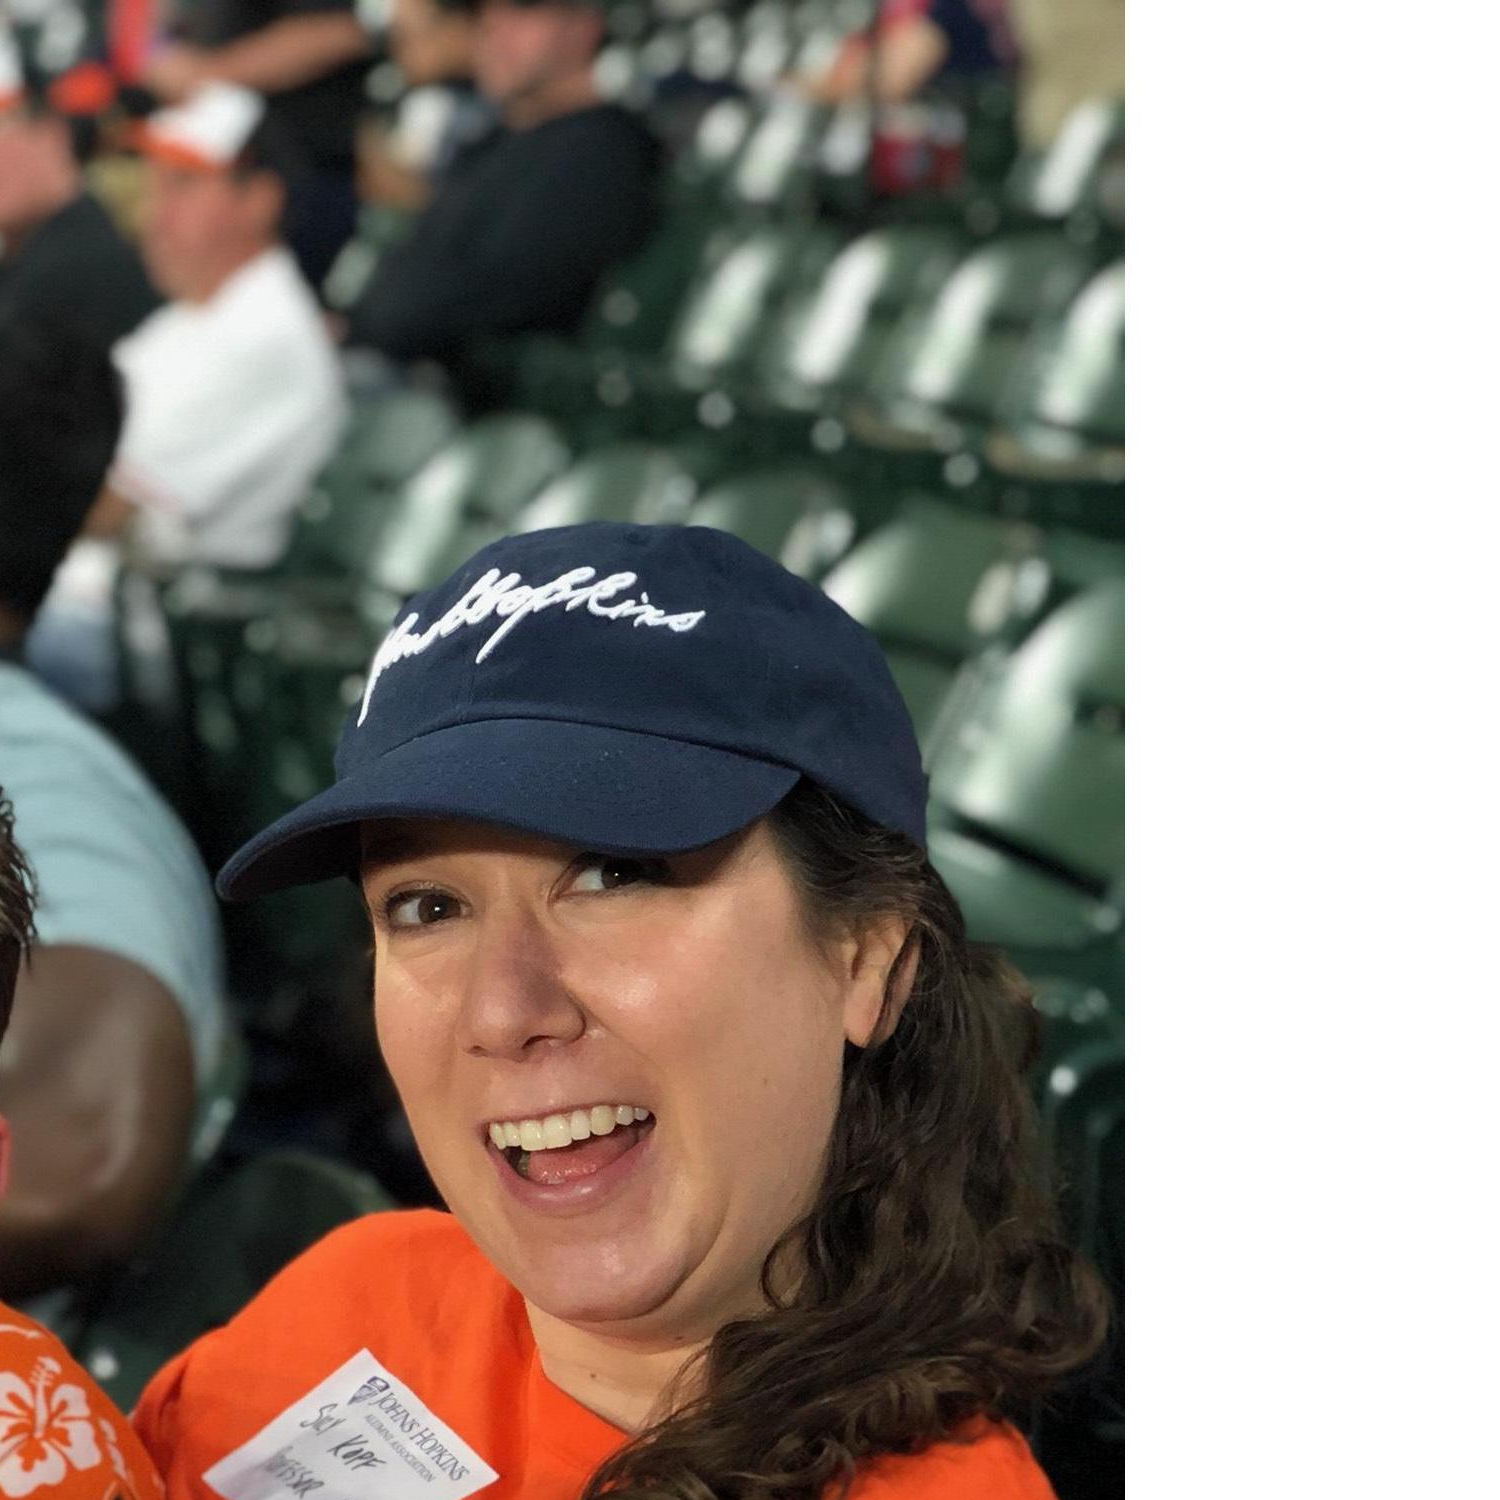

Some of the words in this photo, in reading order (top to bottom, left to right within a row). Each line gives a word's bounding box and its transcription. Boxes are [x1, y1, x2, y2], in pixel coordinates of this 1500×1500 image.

[438, 566, 706, 665] Hopkins
[368, 1392, 420, 1433] JOHNS
[409, 1427, 470, 1481] HOPKINS
[389, 1441, 437, 1483] ASSOCIATION
